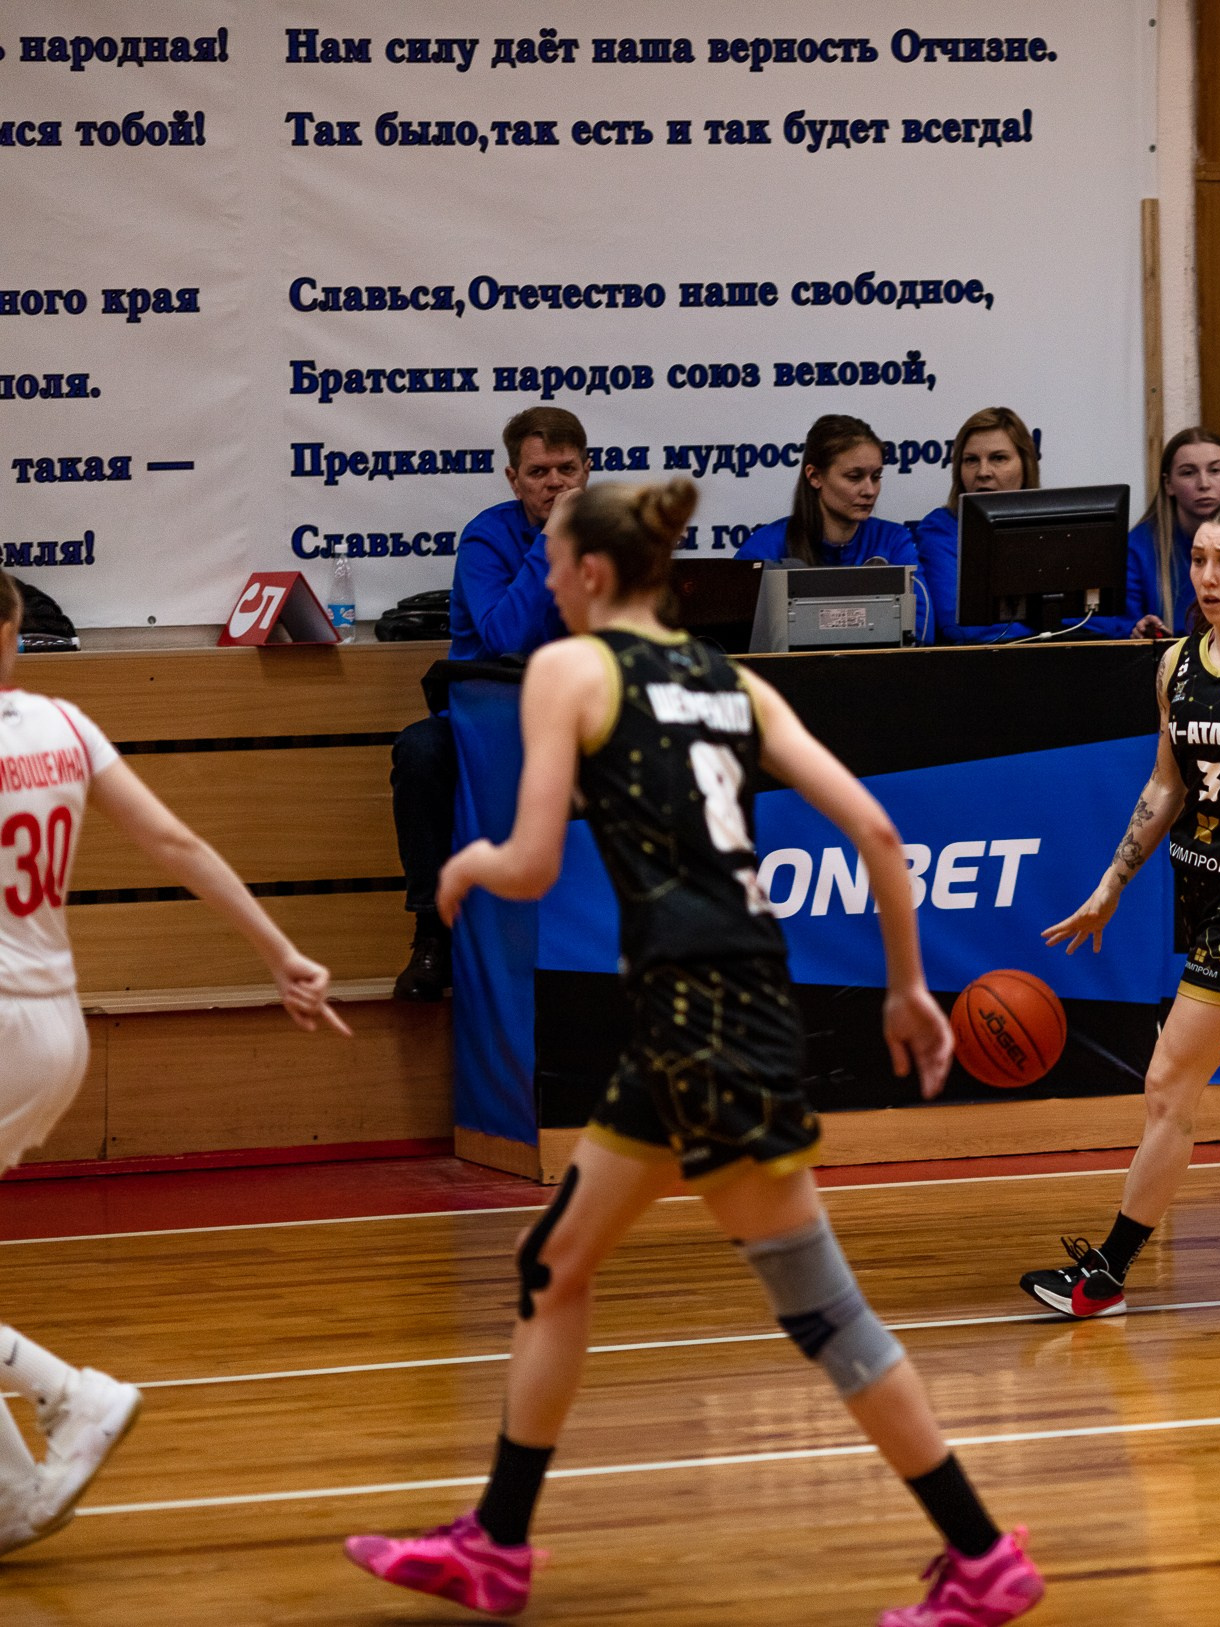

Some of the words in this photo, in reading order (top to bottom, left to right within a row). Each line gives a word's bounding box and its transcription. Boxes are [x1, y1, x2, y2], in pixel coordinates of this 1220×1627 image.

[20, 27, 229, 72] народная!
[285, 29, 372, 63] Нам
[385, 38, 480, 72] силу
[491, 28, 580, 69] даёт
[592, 38, 695, 63] наша
[708, 38, 878, 72] верность
[891, 29, 1057, 63] Отчизне.
[75, 110, 206, 146] тобой!
[285, 112, 362, 146] Так
[572, 121, 653, 145] есть
[667, 121, 691, 144] и
[704, 120, 771, 145] так
[784, 110, 889, 153] будет
[902, 109, 1032, 147] всегда!
[102, 288, 200, 323] края
[679, 282, 778, 308] наше
[791, 271, 994, 310] свободное,
[290, 360, 479, 403] Братских
[493, 365, 654, 398] народов
[667, 363, 760, 389] союз
[774, 351, 936, 391] вековой,
[12, 456, 132, 483] такая
[291, 443, 494, 486] Предками
[663, 442, 805, 479] мудрос
[0, 530, 95, 567] мля!
[0, 805, 73, 918] 30
[978, 1007, 1029, 1076] JÖGEL
